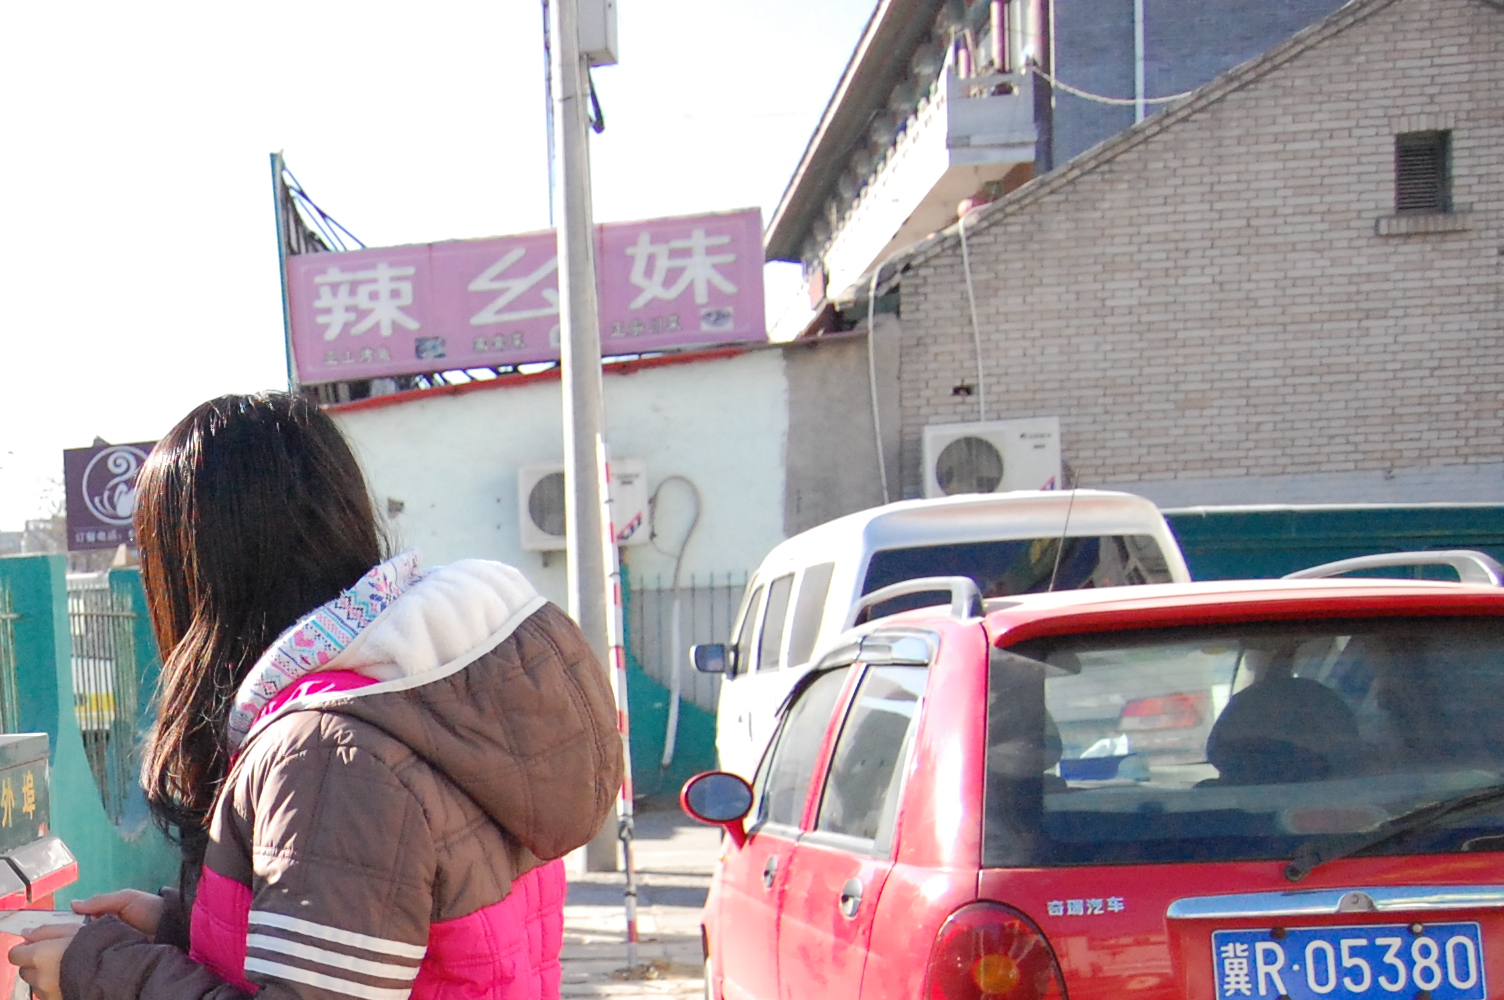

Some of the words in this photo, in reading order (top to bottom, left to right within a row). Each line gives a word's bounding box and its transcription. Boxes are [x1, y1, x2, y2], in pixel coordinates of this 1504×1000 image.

[0, 770, 36, 828] 外埠
[1047, 896, 1124, 916] 奇瑞汽车
